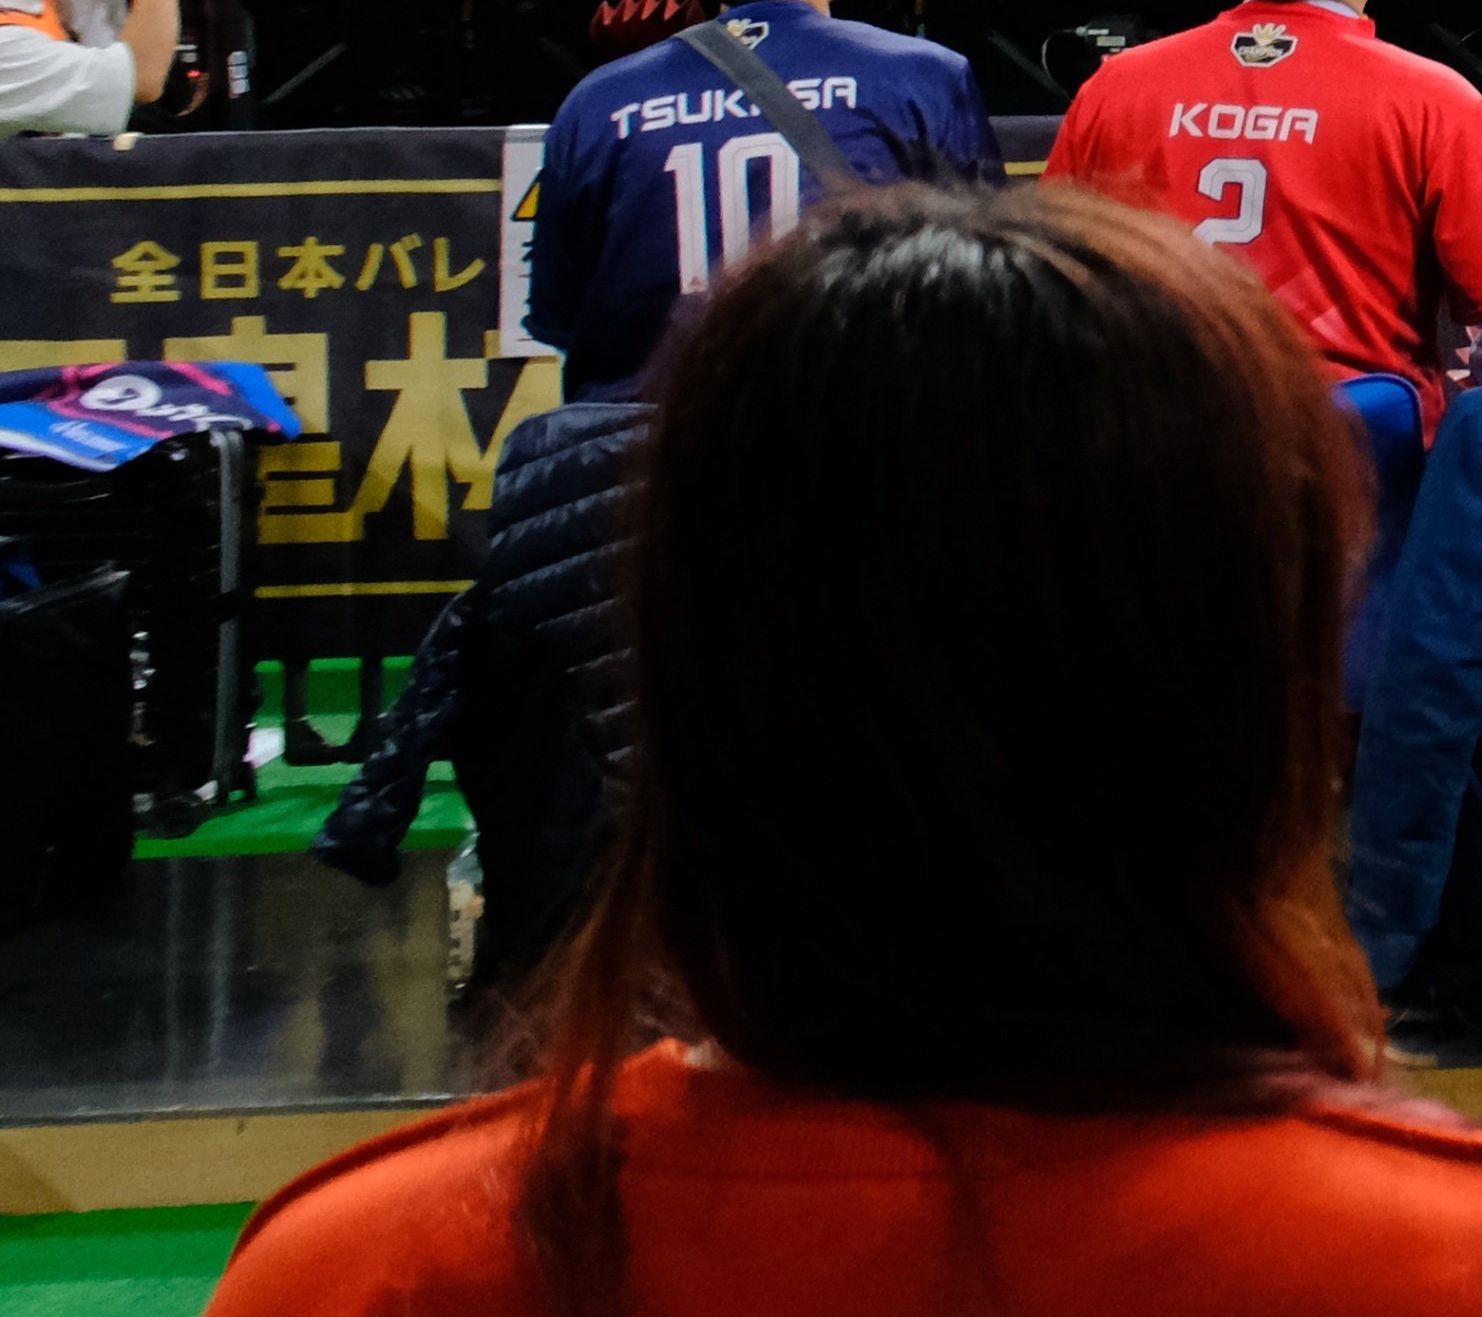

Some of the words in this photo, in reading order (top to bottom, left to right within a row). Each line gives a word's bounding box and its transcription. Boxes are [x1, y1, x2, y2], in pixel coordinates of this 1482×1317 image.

[1167, 102, 1318, 145] KOGA
[665, 133, 800, 295] 10
[1192, 157, 1269, 245] 2
[112, 233, 486, 305] 全日本バレ
